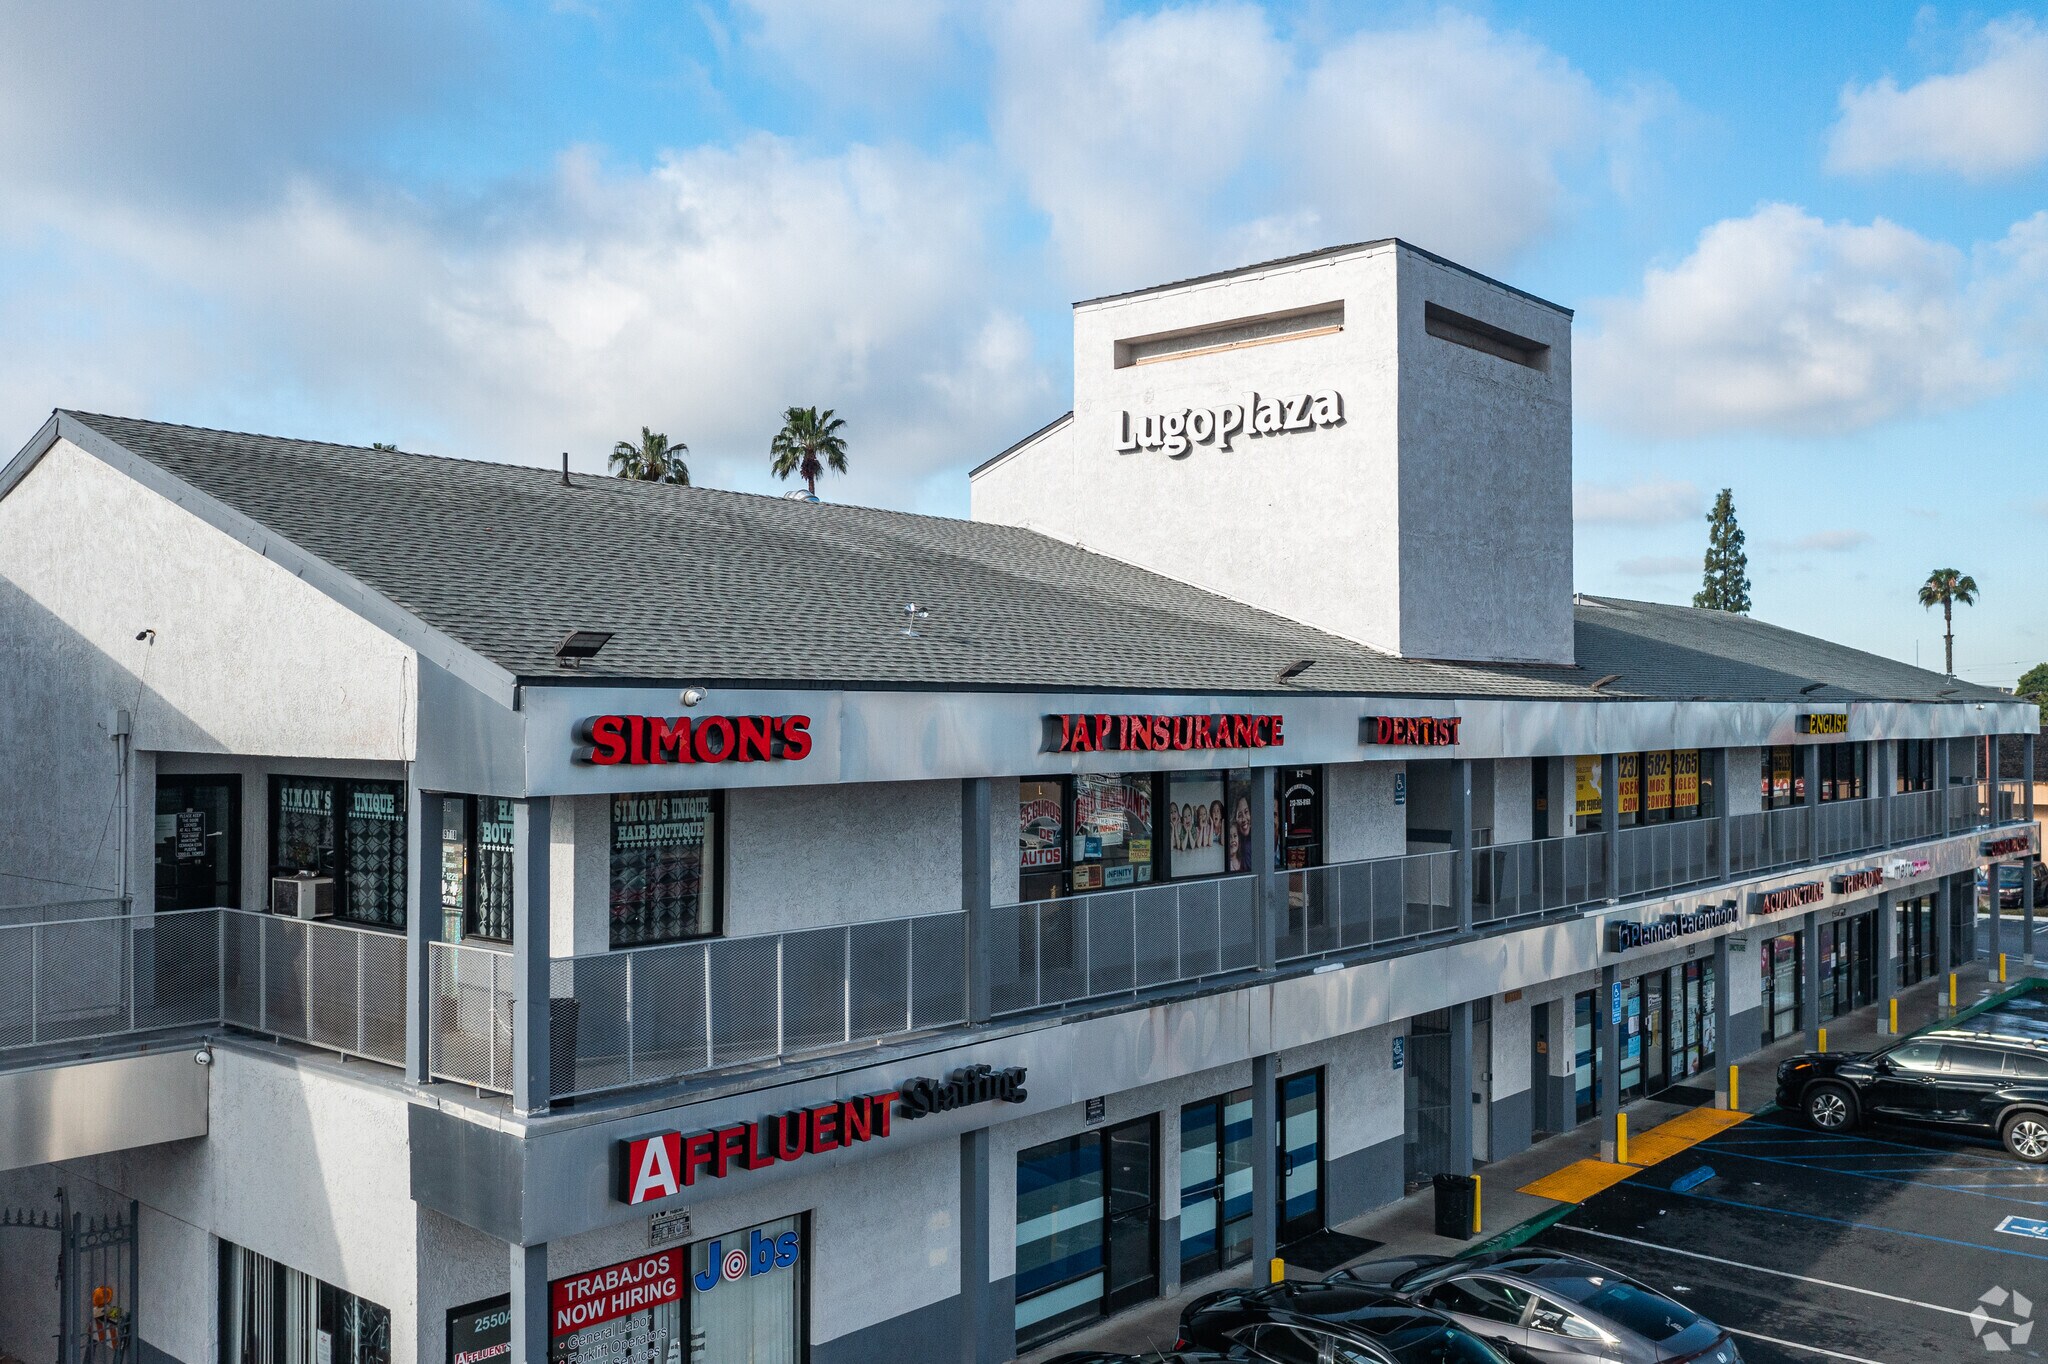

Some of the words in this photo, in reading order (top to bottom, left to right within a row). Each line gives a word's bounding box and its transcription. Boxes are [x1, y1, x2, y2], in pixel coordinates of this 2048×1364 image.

[1112, 389, 1345, 458] Lugoplaza
[591, 715, 813, 766] SIMON'S
[1119, 713, 1285, 751] INSURANCE
[1376, 715, 1462, 746] DENTIST
[1809, 713, 1849, 735] ENGLISH
[281, 787, 332, 810] SIMON'S
[353, 792, 395, 815] UNIQUE
[614, 798, 669, 823] SIMON'S
[671, 797, 709, 821] UNIQUE
[1020, 799, 1061, 830] SEGUROS
[617, 824, 648, 842] HAIR
[648, 821, 705, 840] BOUTIQUE
[1040, 828, 1053, 842] DE
[1021, 849, 1061, 866] AUTOS
[1842, 867, 1884, 895] THREADING
[1762, 881, 1825, 916] ACUPUNCTURE
[629, 1090, 900, 1206] AFFLUENT
[901, 1064, 1028, 1120] Staffing
[693, 1229, 800, 1293] Jobs
[564, 1255, 670, 1302] TRABAJOS
[557, 1297, 607, 1330] NOW
[611, 1277, 677, 1313] HIRING
[567, 1323, 616, 1350] General
[618, 1314, 653, 1335] Labor
[567, 1341, 609, 1364] Forklift
[610, 1326, 668, 1354] Operators
[454, 1342, 507, 1364] AFFLUENT
